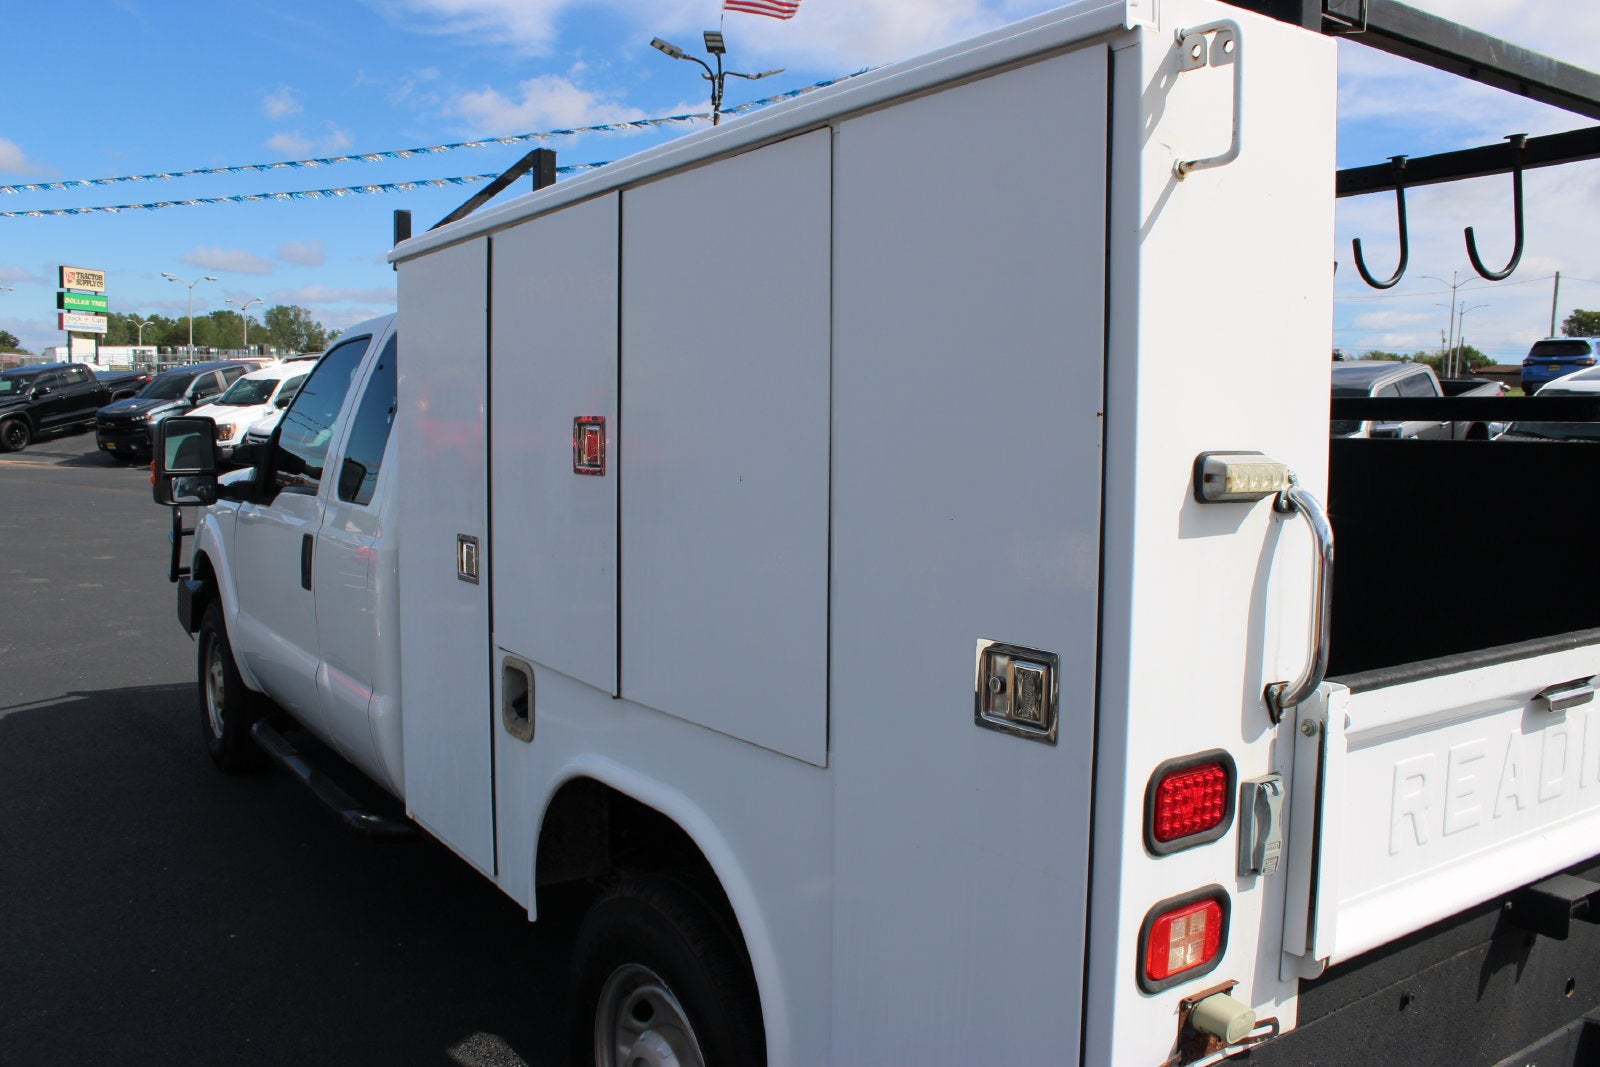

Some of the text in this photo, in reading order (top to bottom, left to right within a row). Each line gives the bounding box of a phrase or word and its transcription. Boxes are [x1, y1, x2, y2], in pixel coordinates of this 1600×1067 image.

[76, 272, 103, 281] TRACTOR
[76, 279, 96, 287] SUPPLY
[65, 297, 90, 305] DOLLAR
[92, 316, 105, 324] Care
[1389, 707, 1600, 856] READI
